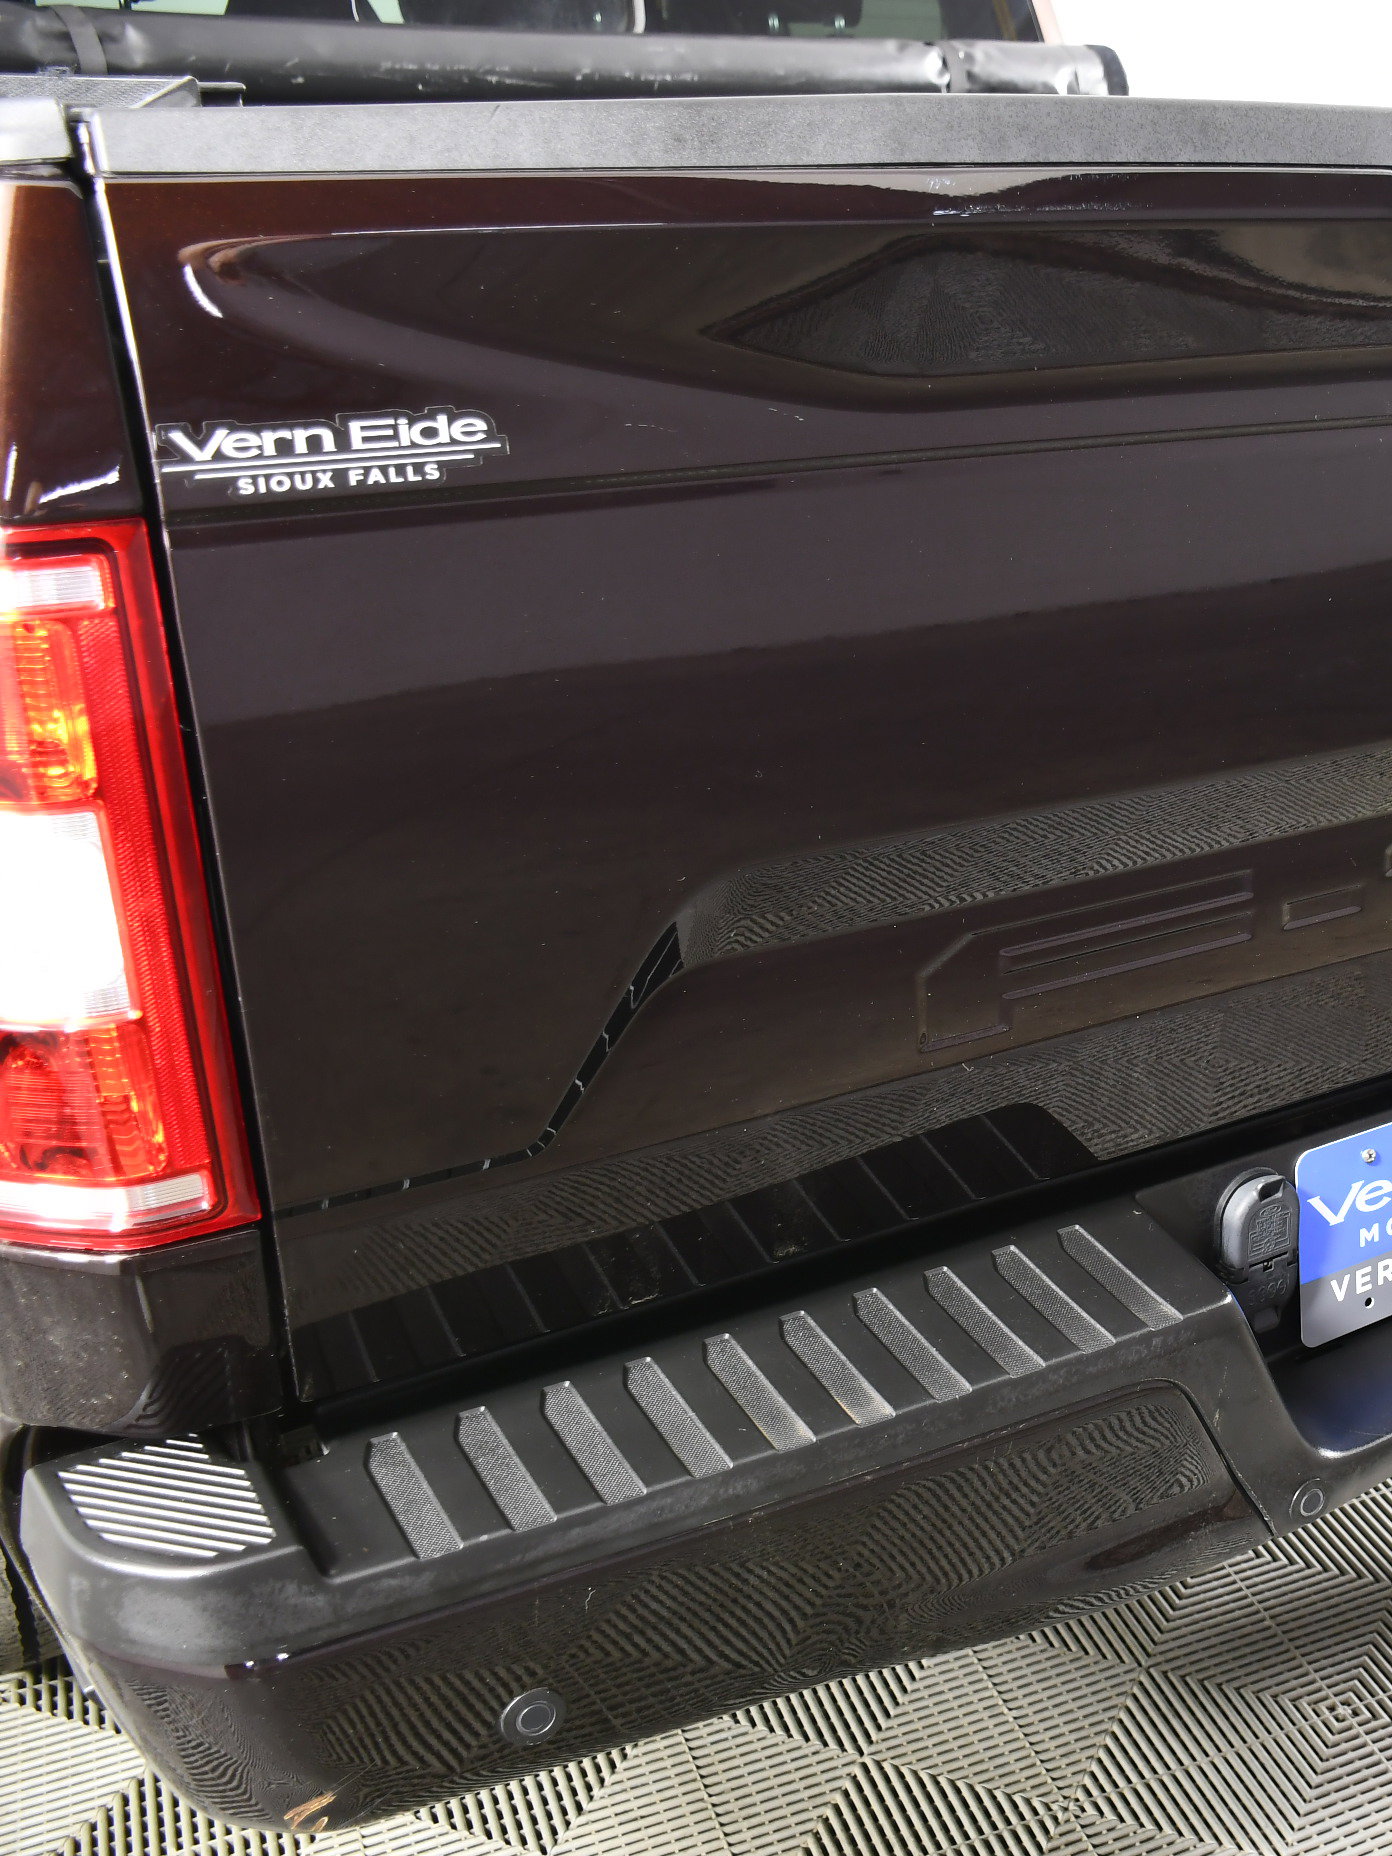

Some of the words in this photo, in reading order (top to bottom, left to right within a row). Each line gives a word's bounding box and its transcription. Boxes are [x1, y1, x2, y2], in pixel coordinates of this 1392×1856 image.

[168, 427, 338, 461] Vern
[348, 414, 488, 450] Eide
[236, 470, 336, 496] SIOUX
[348, 463, 442, 487] FALLS
